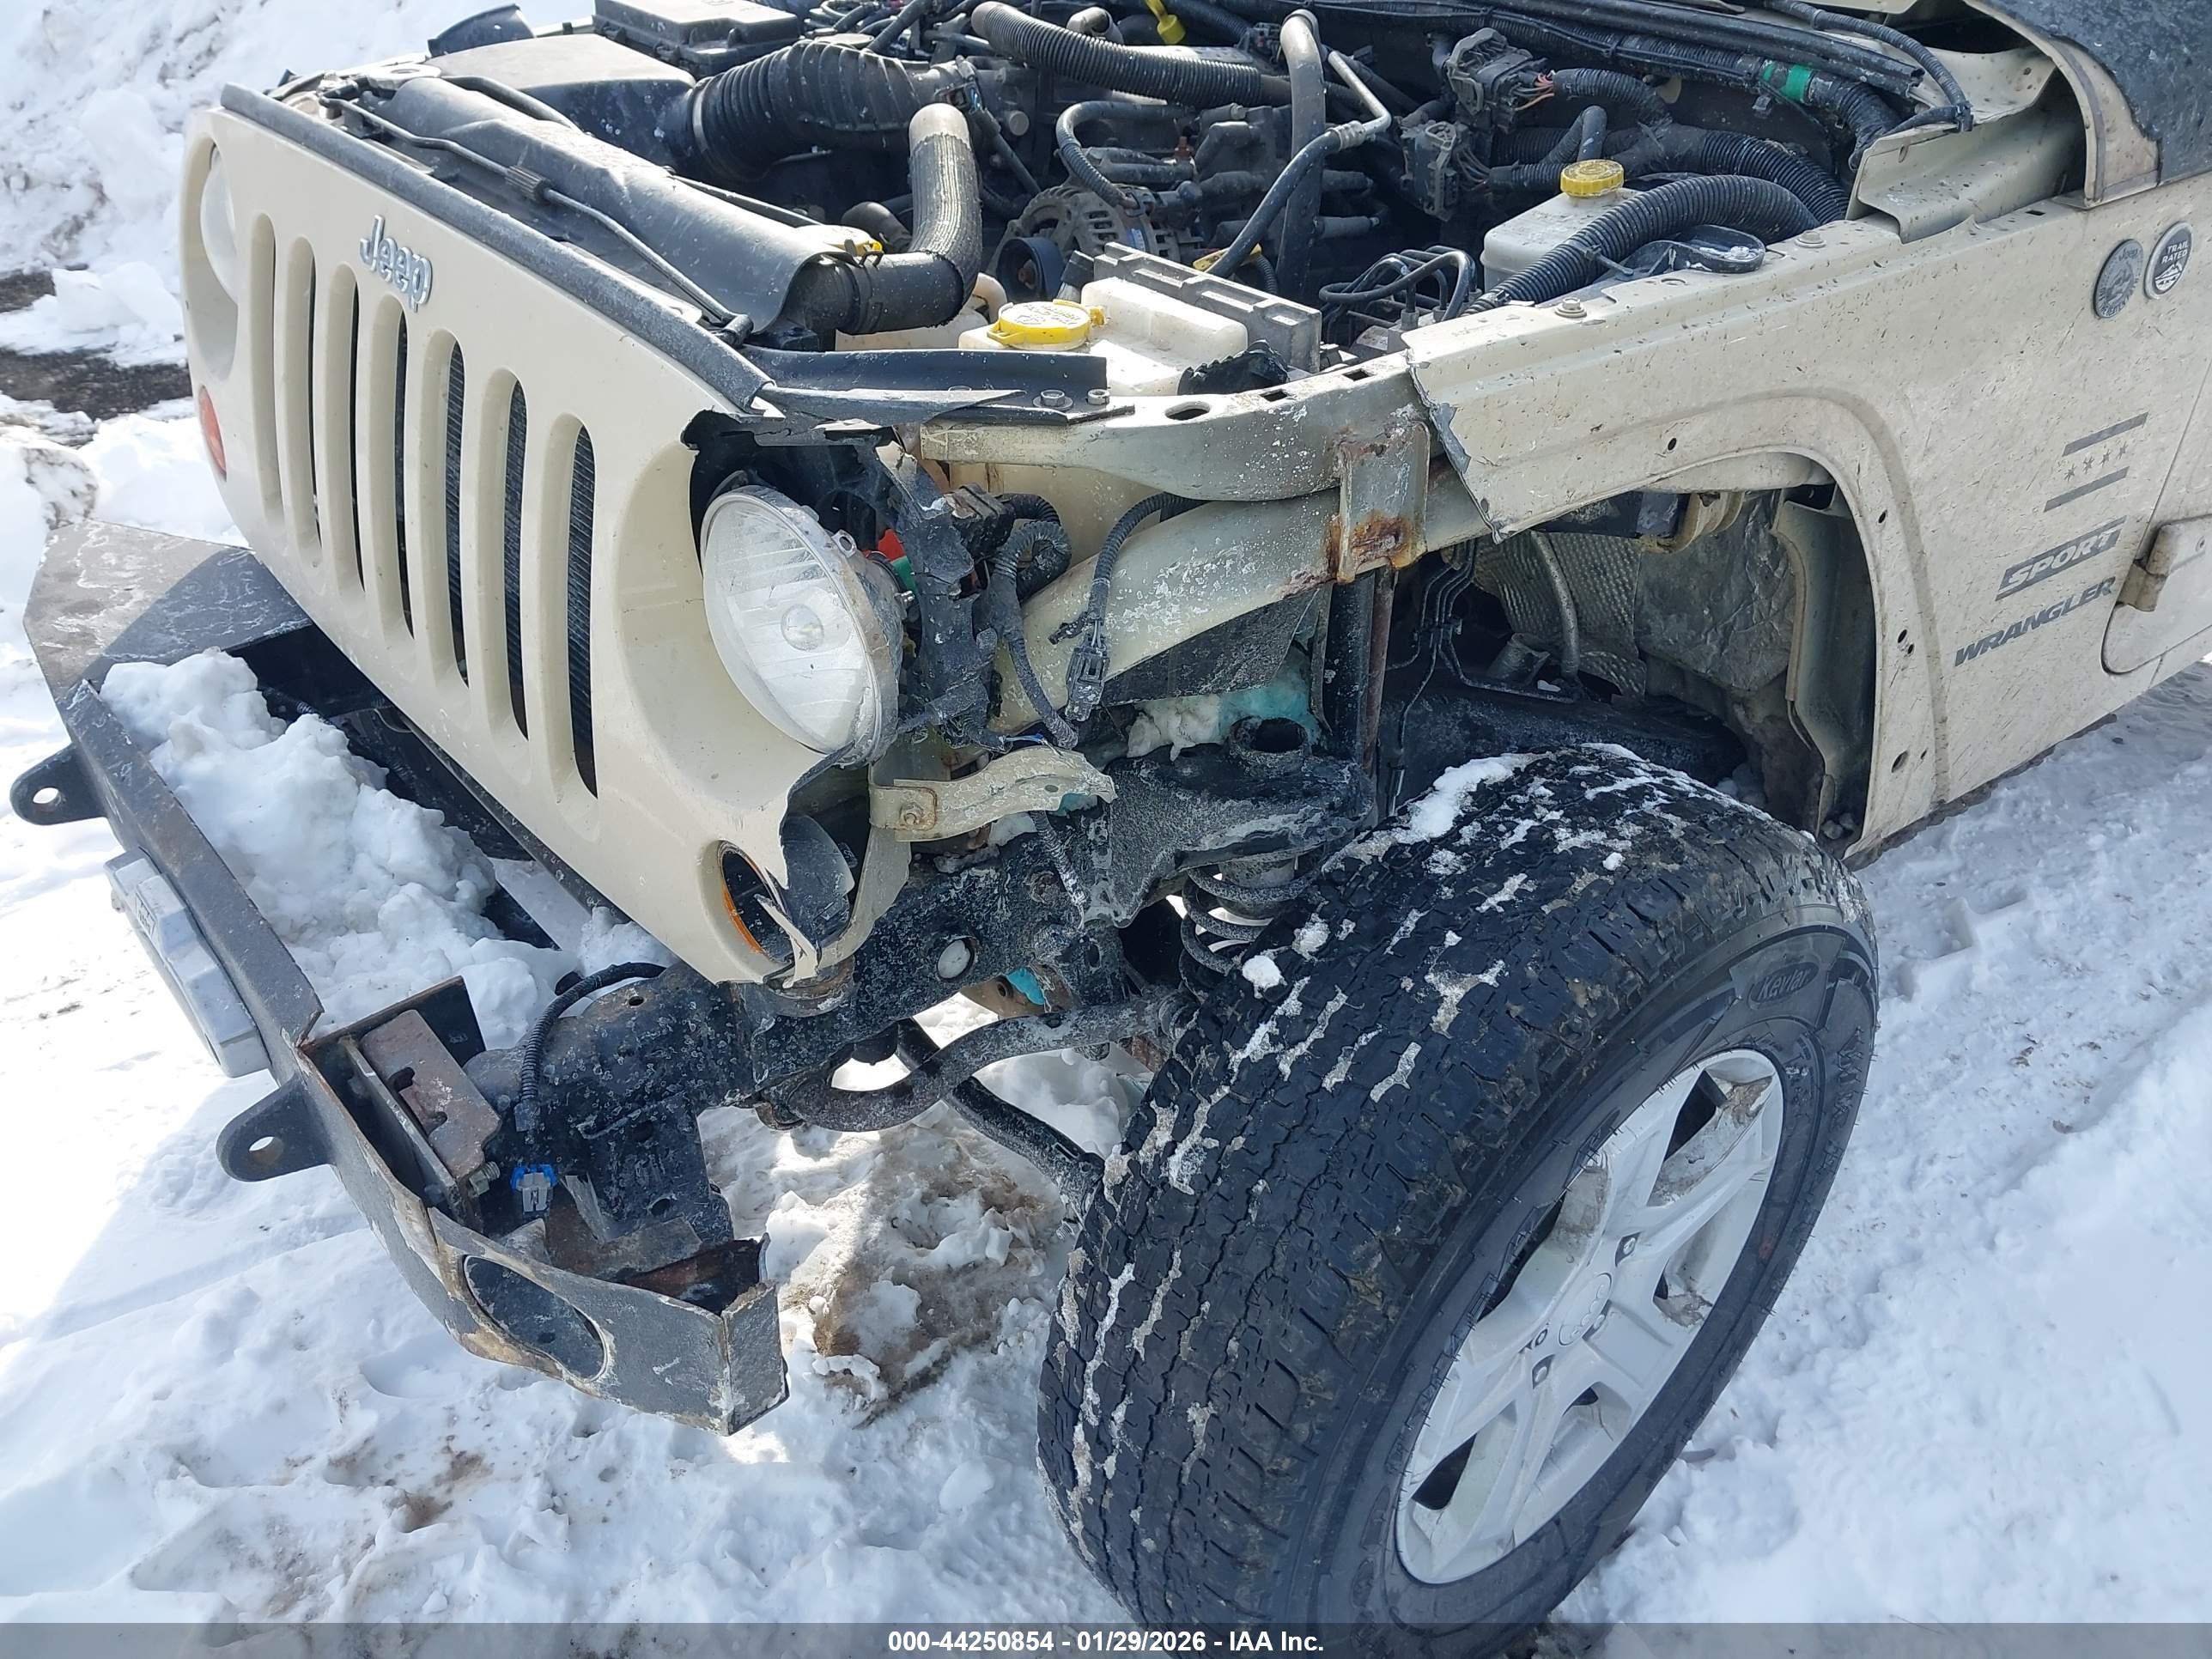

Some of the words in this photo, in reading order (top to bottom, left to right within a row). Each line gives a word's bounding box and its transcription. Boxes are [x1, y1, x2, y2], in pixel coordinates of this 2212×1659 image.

[360, 214, 433, 313] Jeep
[2161, 249, 2188, 264] RATED
[2166, 240, 2189, 254] TRAIL
[2008, 525, 2124, 585] SPORT
[1954, 576, 2116, 667] WRANGLER
[1757, 967, 1813, 1001] Kevlar
